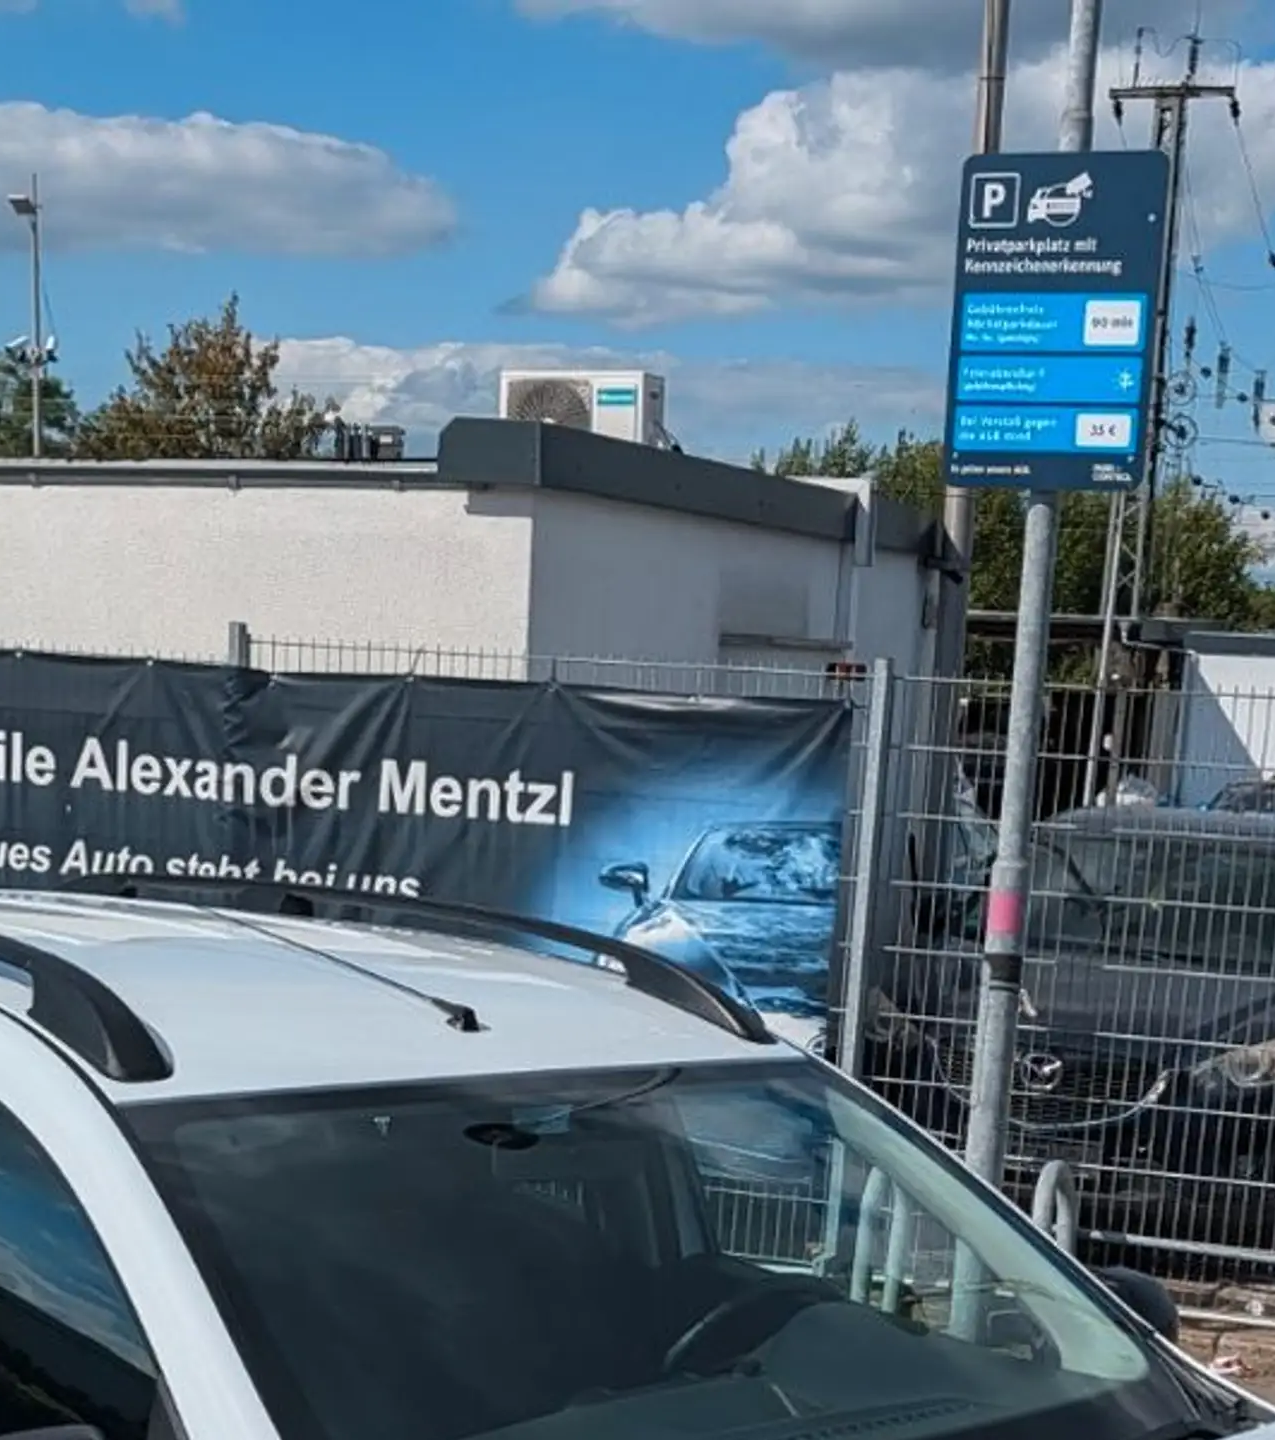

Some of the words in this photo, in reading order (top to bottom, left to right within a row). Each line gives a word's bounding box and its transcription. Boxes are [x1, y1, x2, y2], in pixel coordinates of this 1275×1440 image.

[982, 182, 1007, 219] P
[967, 236, 1070, 255] Privatparkplatz
[1073, 236, 1097, 253] mit
[964, 257, 1123, 277] Kennzeichenerkennung
[71, 738, 358, 809] Alexander
[377, 760, 573, 826] Mentzl
[60, 839, 153, 876] Auto
